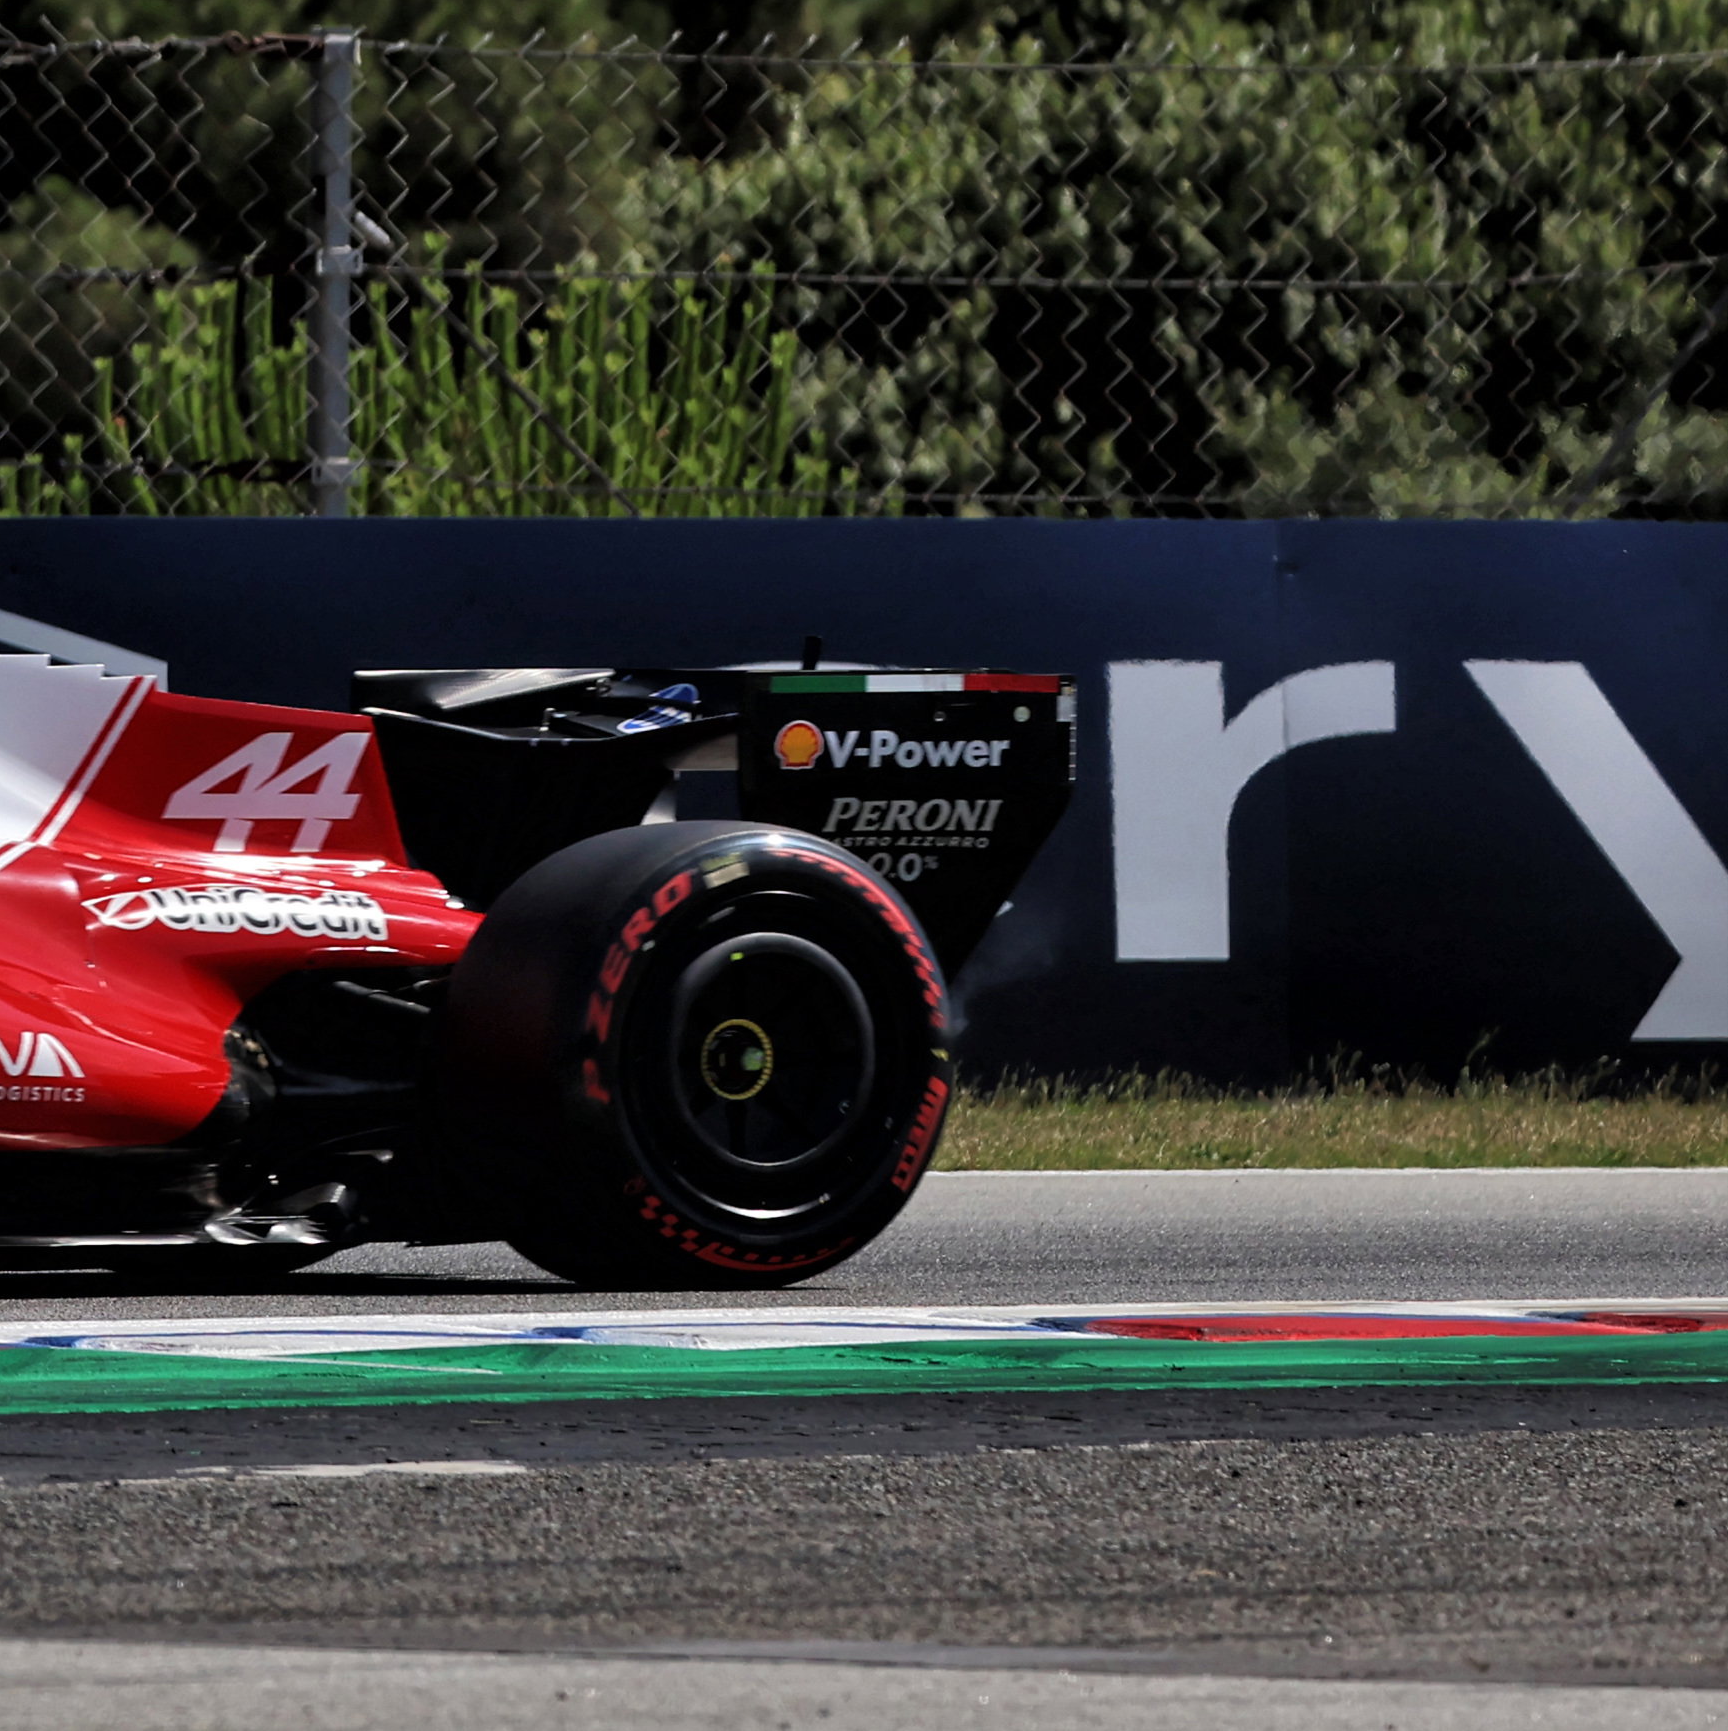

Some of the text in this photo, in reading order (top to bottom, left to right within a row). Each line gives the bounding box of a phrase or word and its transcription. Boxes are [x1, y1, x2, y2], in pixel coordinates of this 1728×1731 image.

[824, 729, 1011, 769] V-Power
[162, 732, 372, 853] 44
[822, 797, 1004, 833] PERONI
[829, 836, 991, 849] ASTRO AZZURRO
[585, 869, 695, 1043] ZERO
